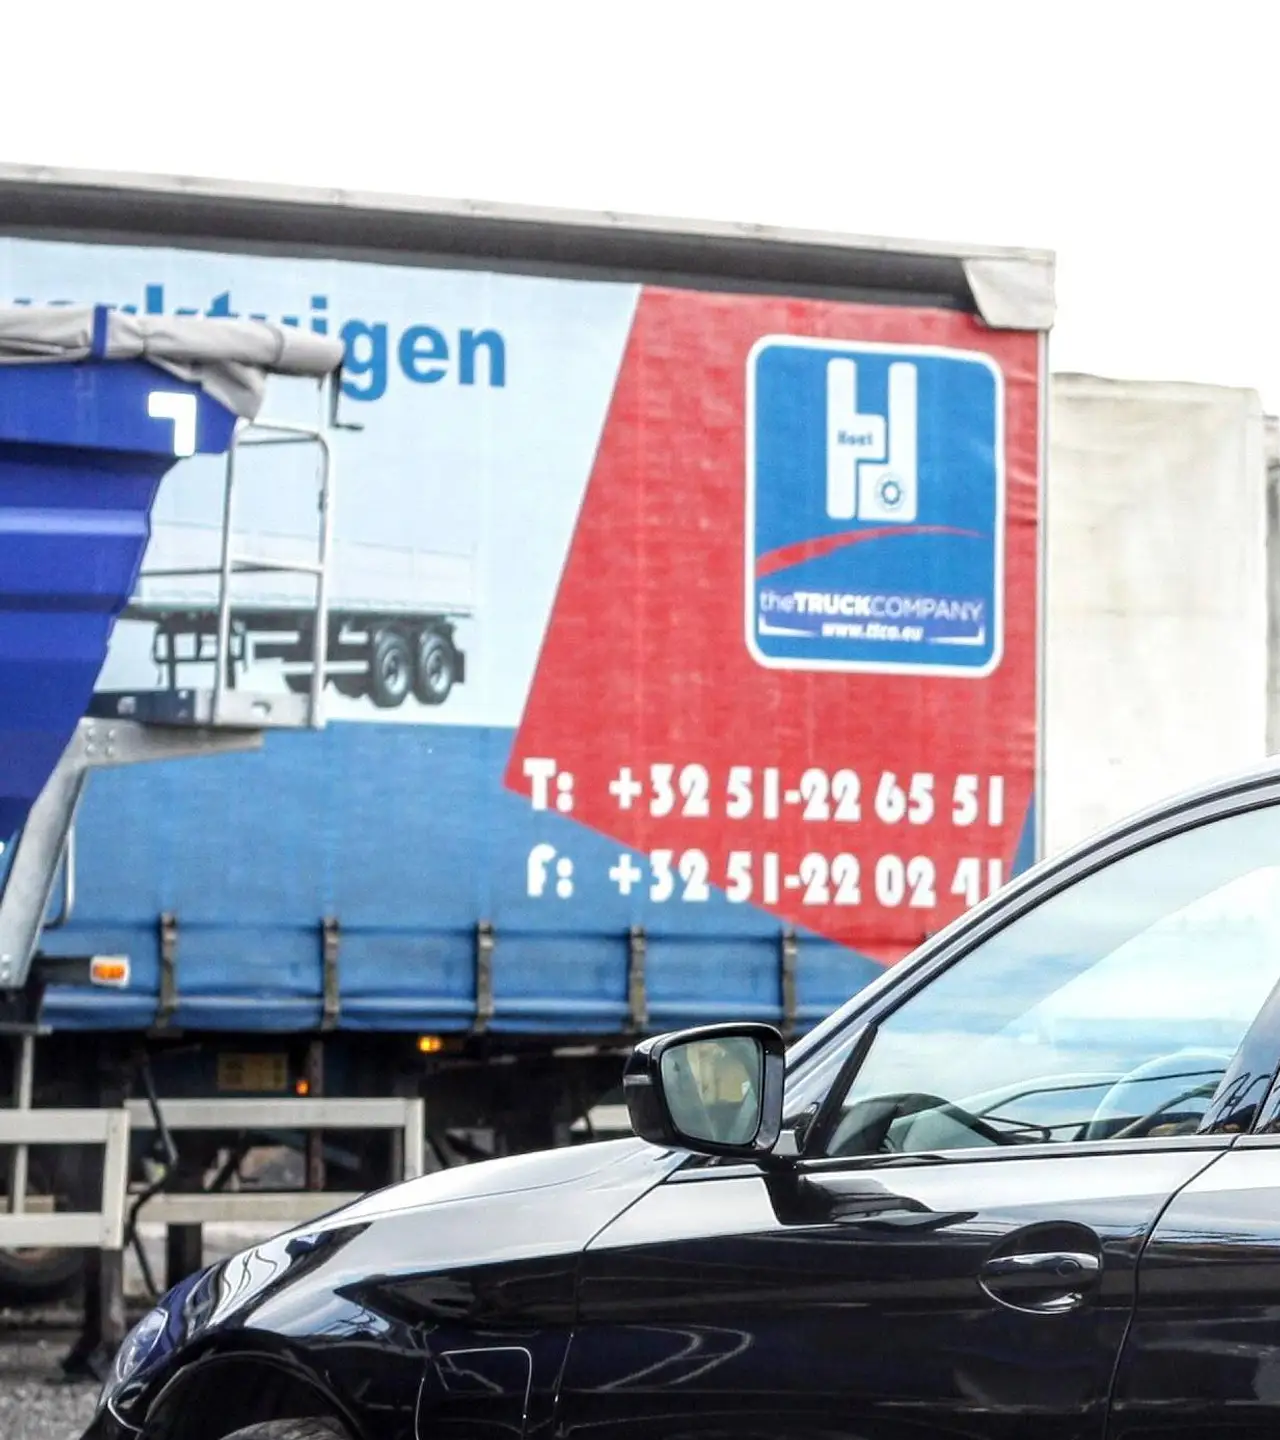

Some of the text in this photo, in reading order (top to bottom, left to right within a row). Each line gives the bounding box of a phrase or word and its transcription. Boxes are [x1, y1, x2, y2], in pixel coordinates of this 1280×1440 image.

[523, 757, 1004, 827] T: +32 51-22 65 51
[608, 849, 710, 902] +32
[726, 851, 861, 905] 51-22
[874, 855, 936, 907] 02
